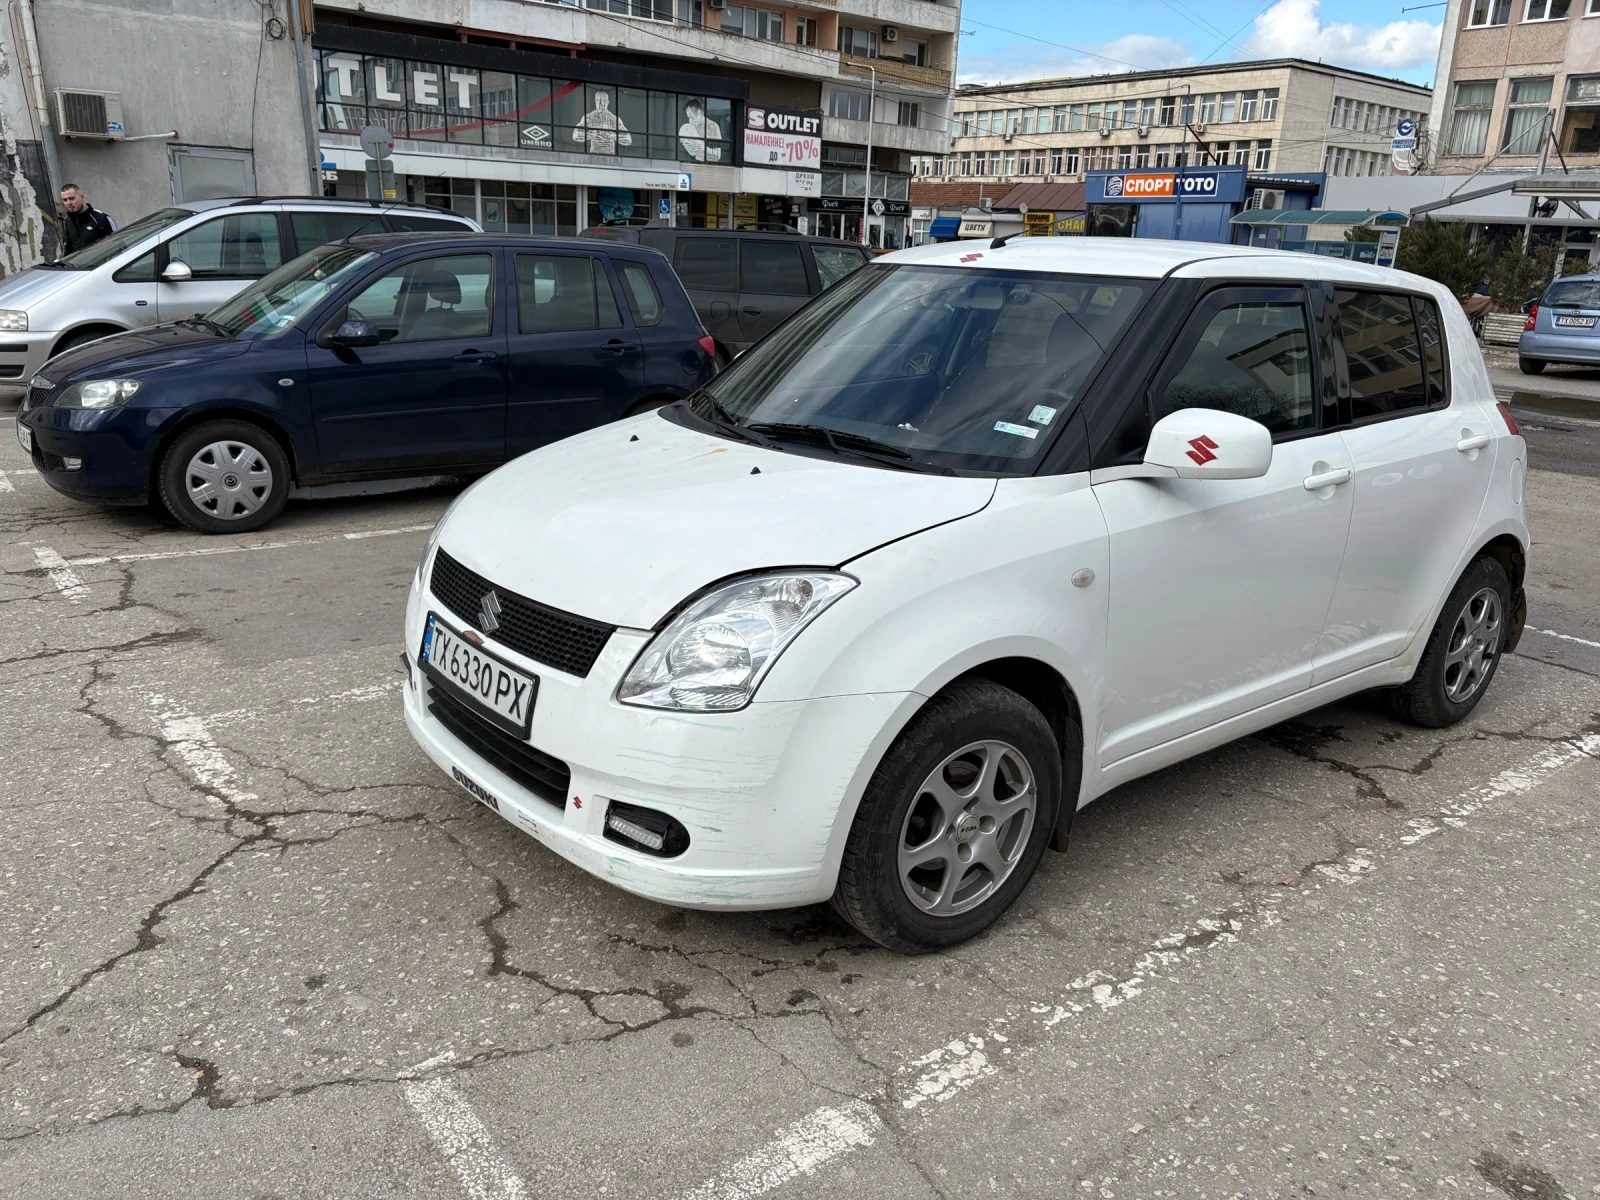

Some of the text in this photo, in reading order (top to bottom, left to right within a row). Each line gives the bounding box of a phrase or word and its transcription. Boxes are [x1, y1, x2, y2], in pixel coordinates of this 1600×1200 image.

[312, 58, 478, 109] TLET
[767, 113, 819, 133] OUTLET
[520, 139, 552, 147] UMBRO
[746, 133, 785, 148] НАМАЛЕНИЕ!
[781, 139, 819, 162] -70%
[1126, 179, 1173, 192] СПОРТ
[964, 223, 986, 232] ЦВЕТЯ
[451, 643, 492, 698] 6330
[452, 765, 500, 813] SUZUKI
